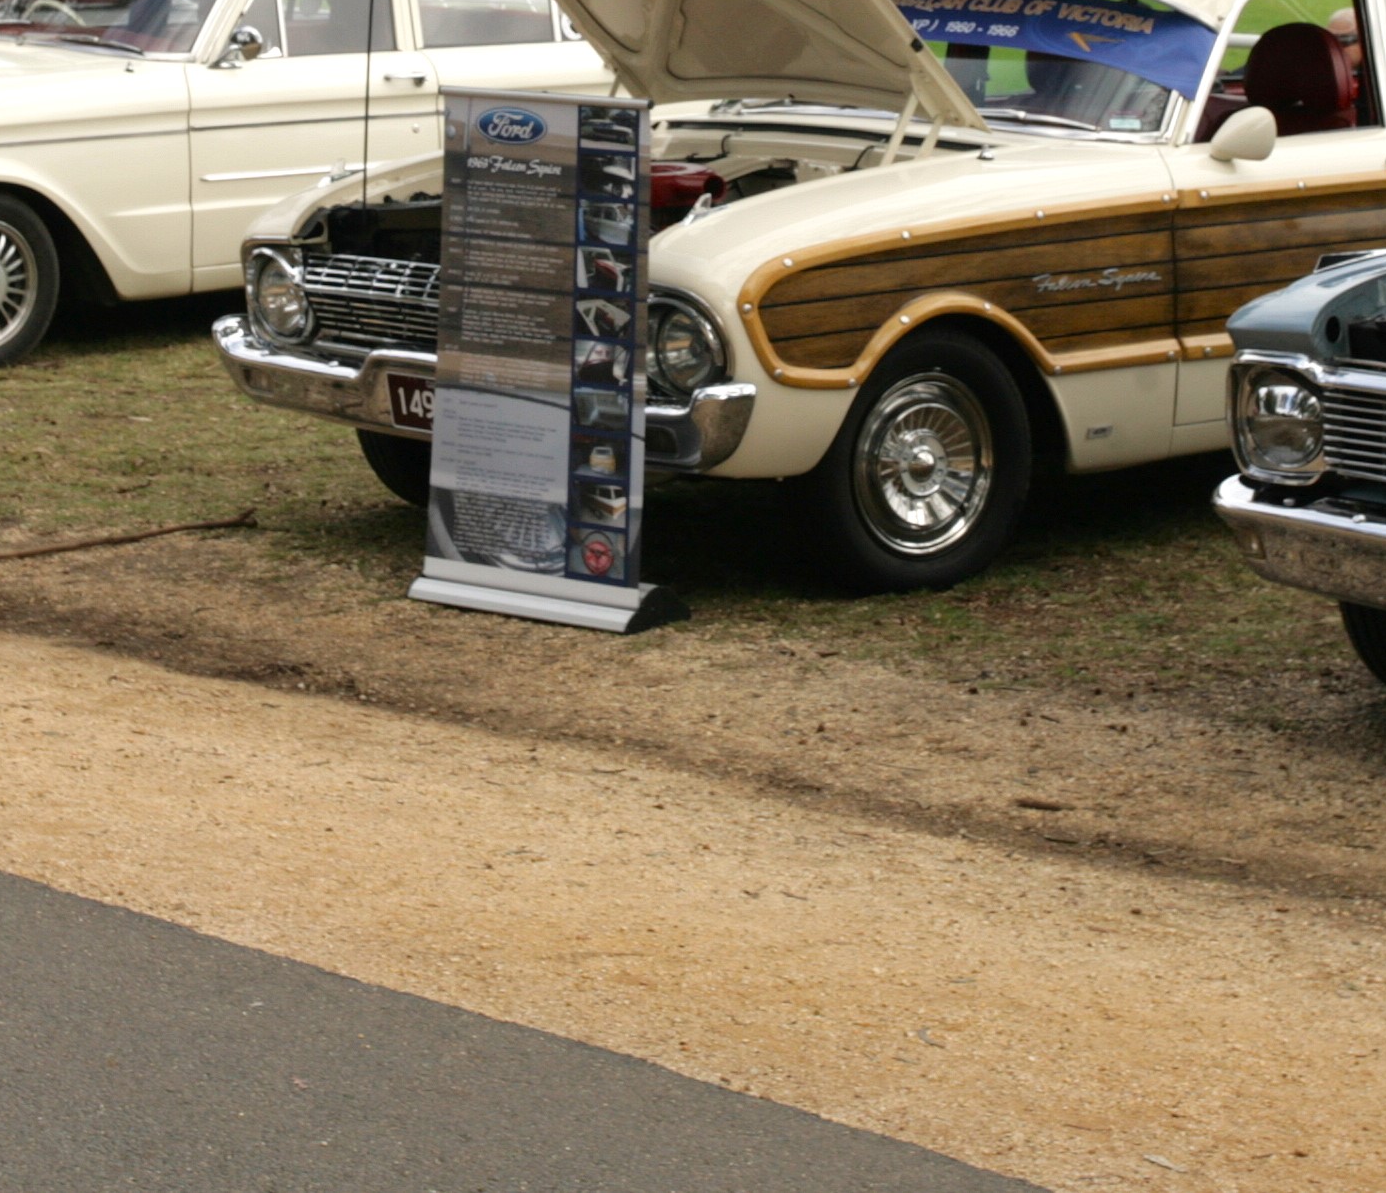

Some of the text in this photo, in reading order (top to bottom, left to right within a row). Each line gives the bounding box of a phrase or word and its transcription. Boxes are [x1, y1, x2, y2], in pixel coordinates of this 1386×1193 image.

[944, 21, 976, 34] 1960
[987, 24, 1020, 38] 1966
[1057, 2, 1155, 35] VICTORIA
[487, 111, 534, 139] Ford
